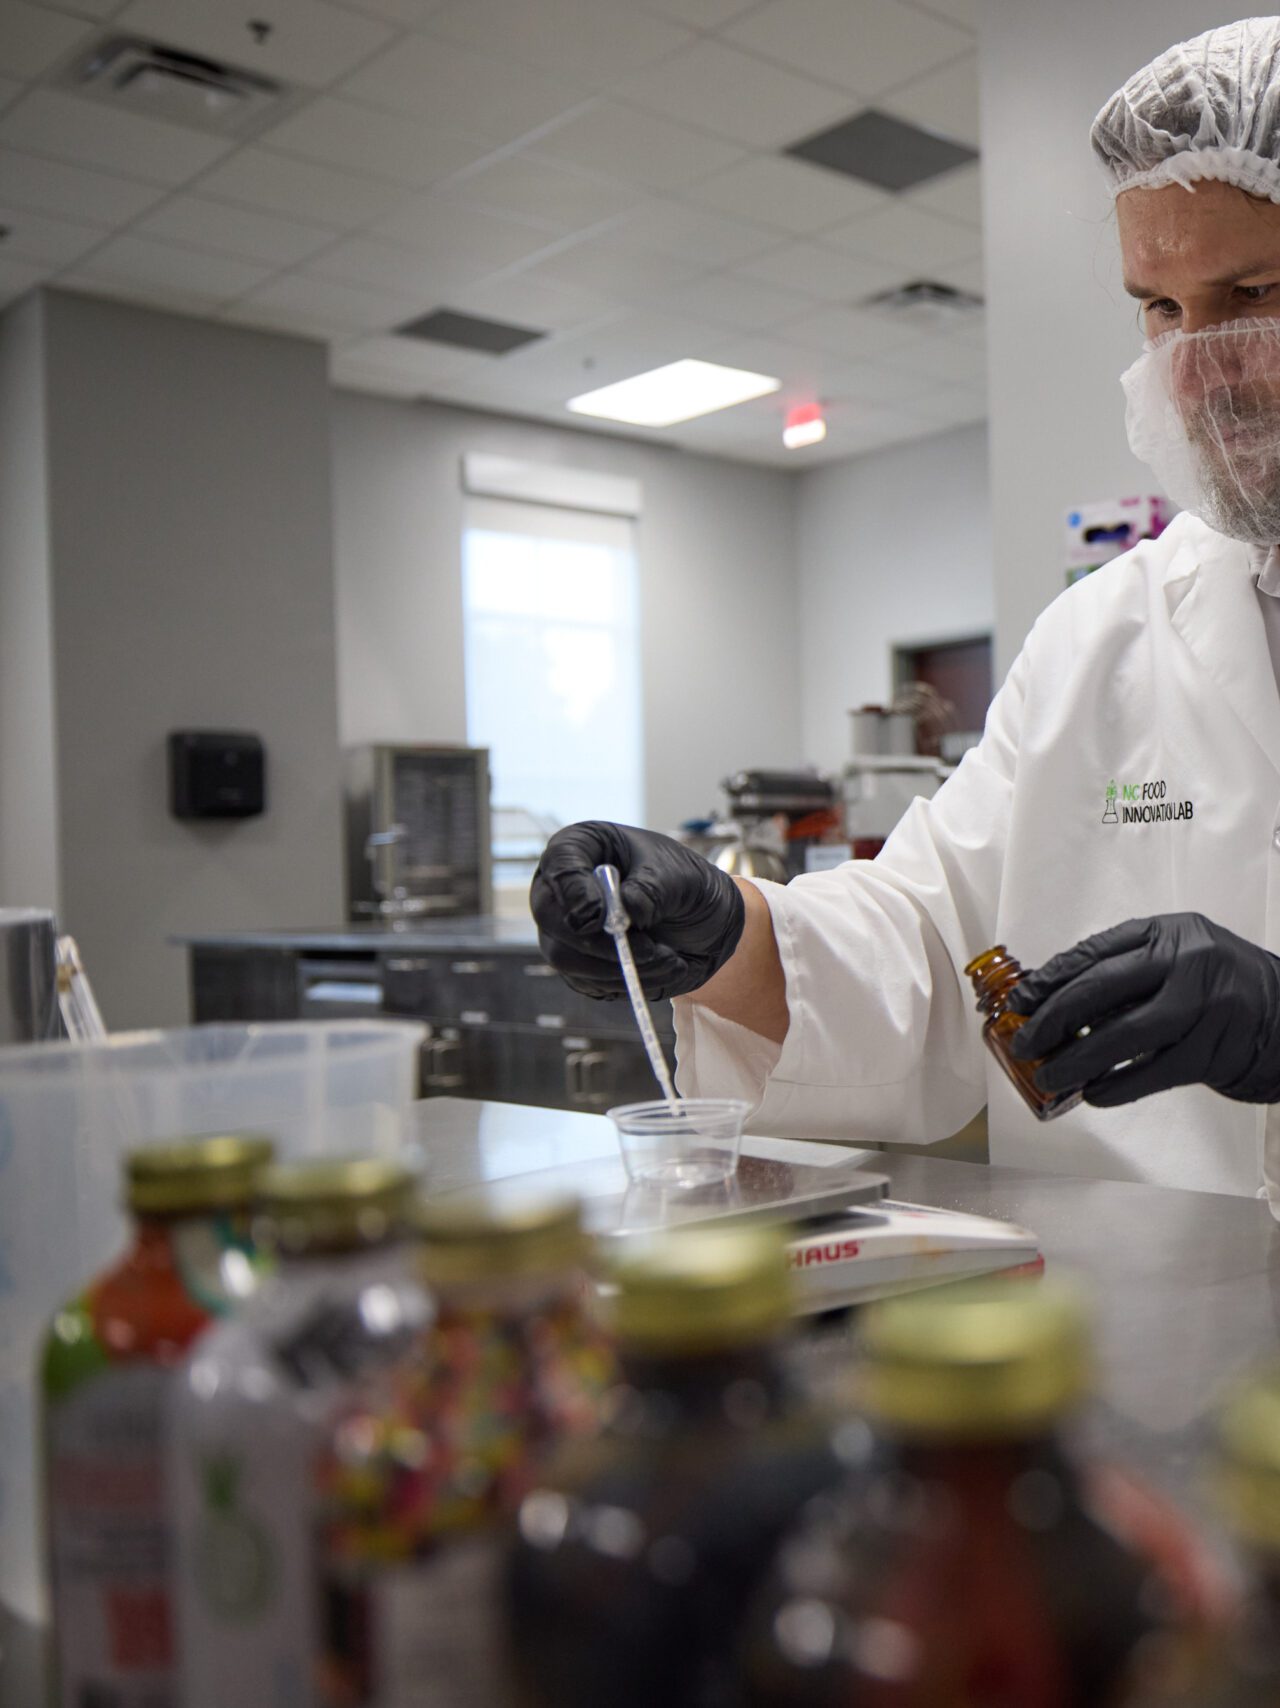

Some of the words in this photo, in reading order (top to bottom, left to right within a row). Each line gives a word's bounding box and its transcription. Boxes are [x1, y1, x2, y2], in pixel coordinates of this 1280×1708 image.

[1122, 784, 1140, 801] NC
[1142, 780, 1167, 800] FOOD
[1122, 803, 1173, 824] INNOVATIO
[1173, 800, 1194, 820] LAB
[784, 1240, 860, 1269] HAUS
